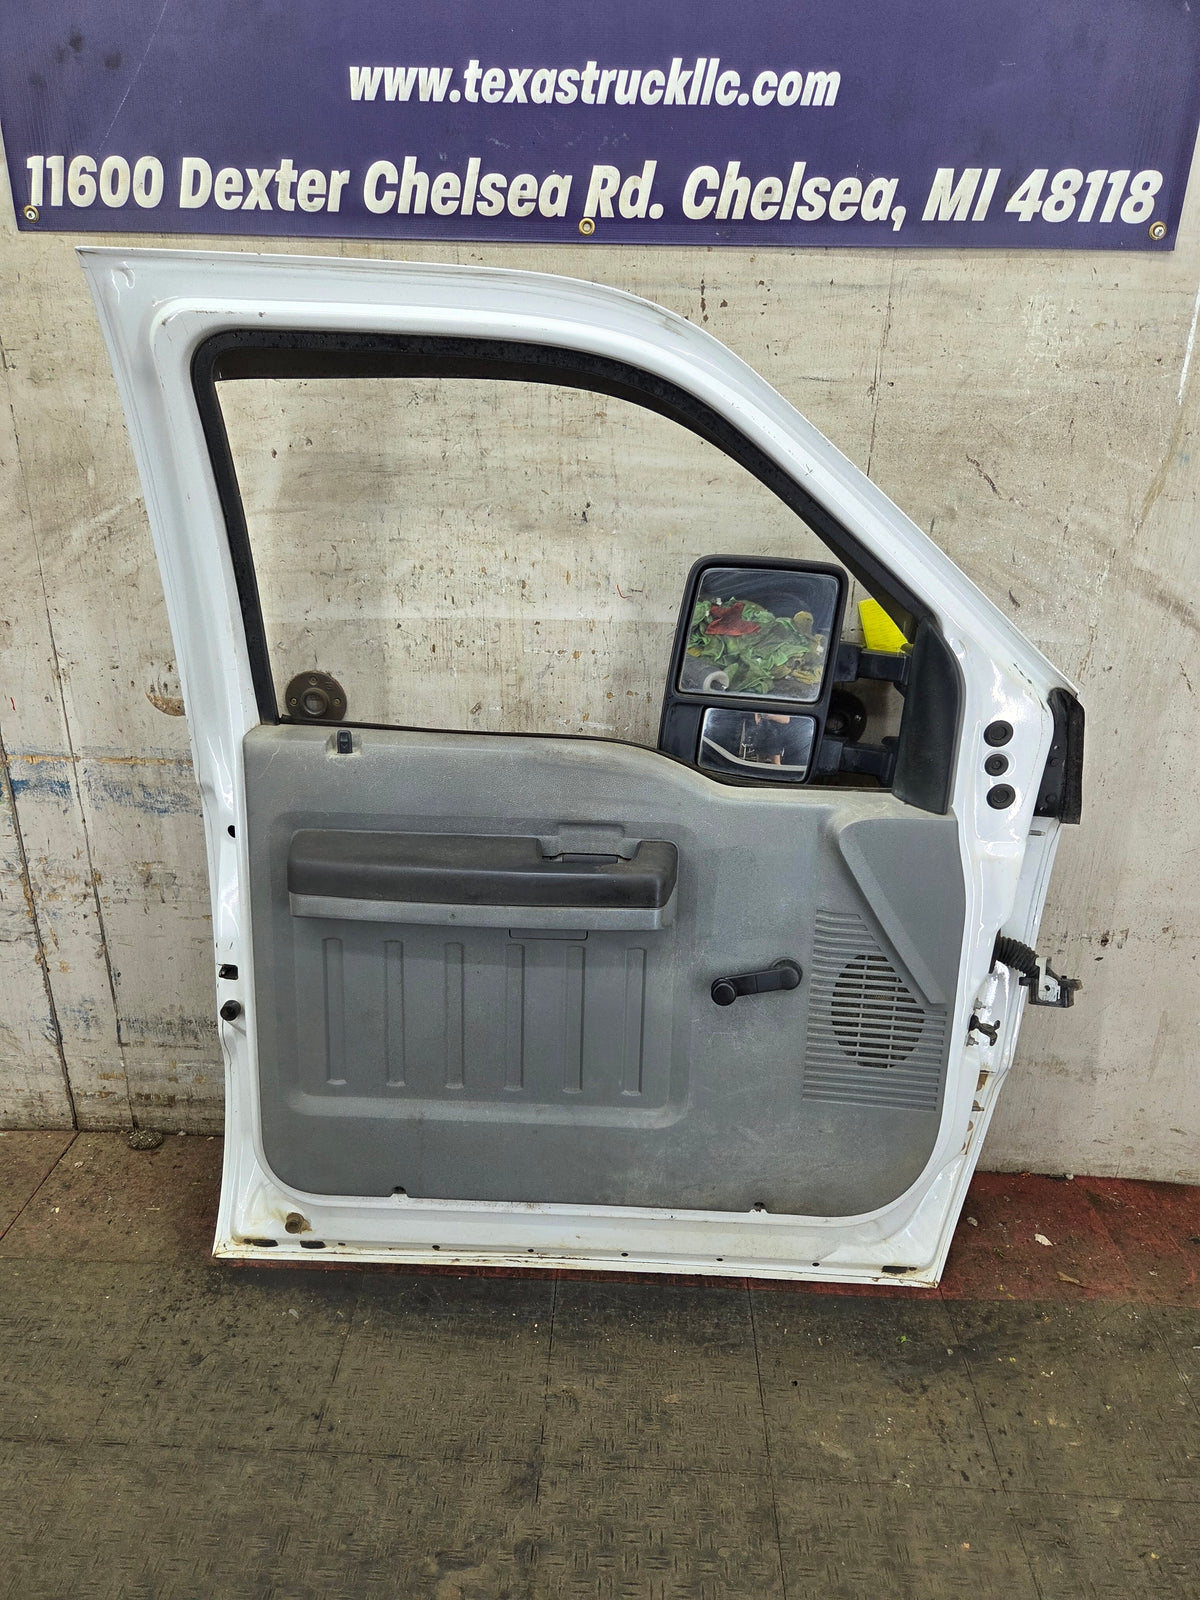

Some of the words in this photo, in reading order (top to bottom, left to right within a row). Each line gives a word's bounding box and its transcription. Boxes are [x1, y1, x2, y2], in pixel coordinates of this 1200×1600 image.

[349, 58, 841, 107] www.texastruckllc.com
[27, 154, 165, 209] 11600
[180, 156, 350, 213] Dexter
[364, 156, 573, 218] Chelsea
[583, 160, 663, 220] Rd.
[682, 161, 905, 232] Chelsea,
[922, 168, 1001, 222] MI
[1005, 168, 1164, 225] 48118
